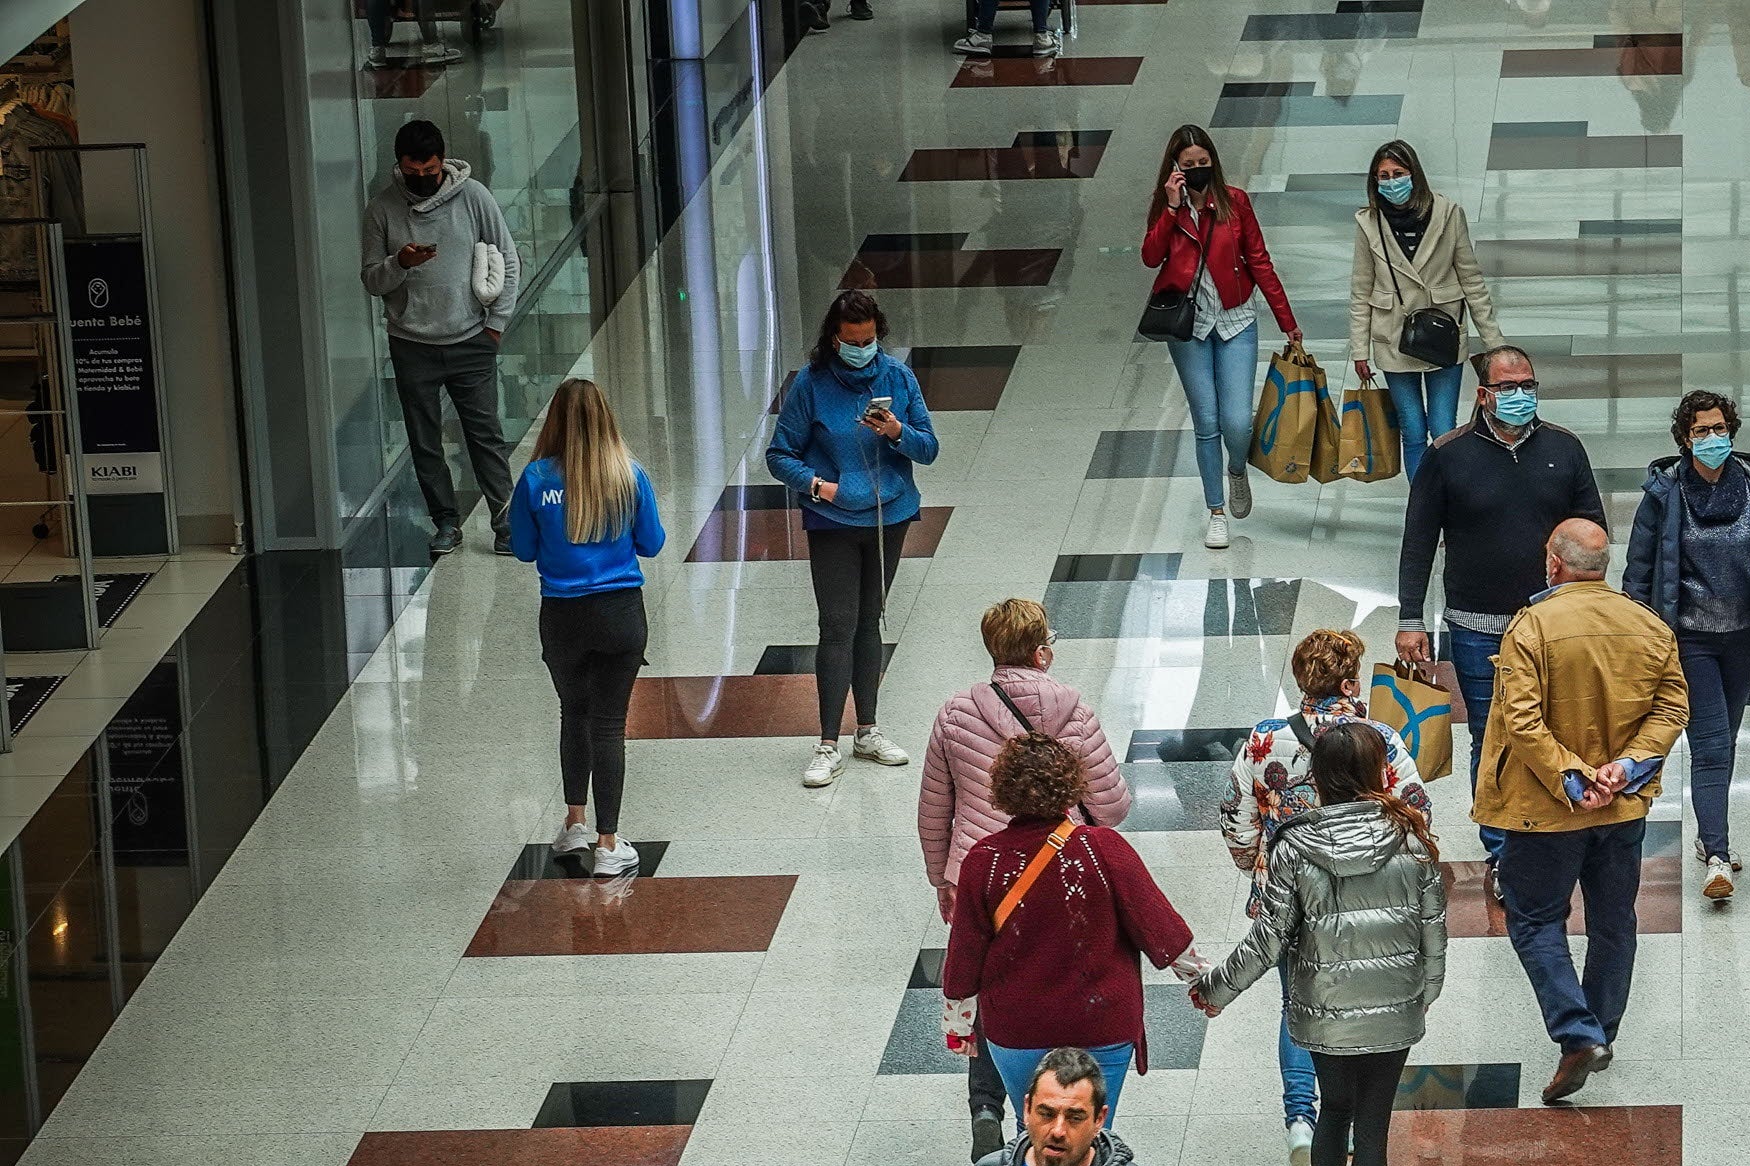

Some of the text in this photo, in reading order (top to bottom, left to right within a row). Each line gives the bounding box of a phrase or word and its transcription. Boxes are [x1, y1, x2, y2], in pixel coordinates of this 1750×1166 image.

[70, 315, 142, 327] uenta Bebé
[91, 466, 138, 477] KIABI
[541, 489, 564, 506] MY
